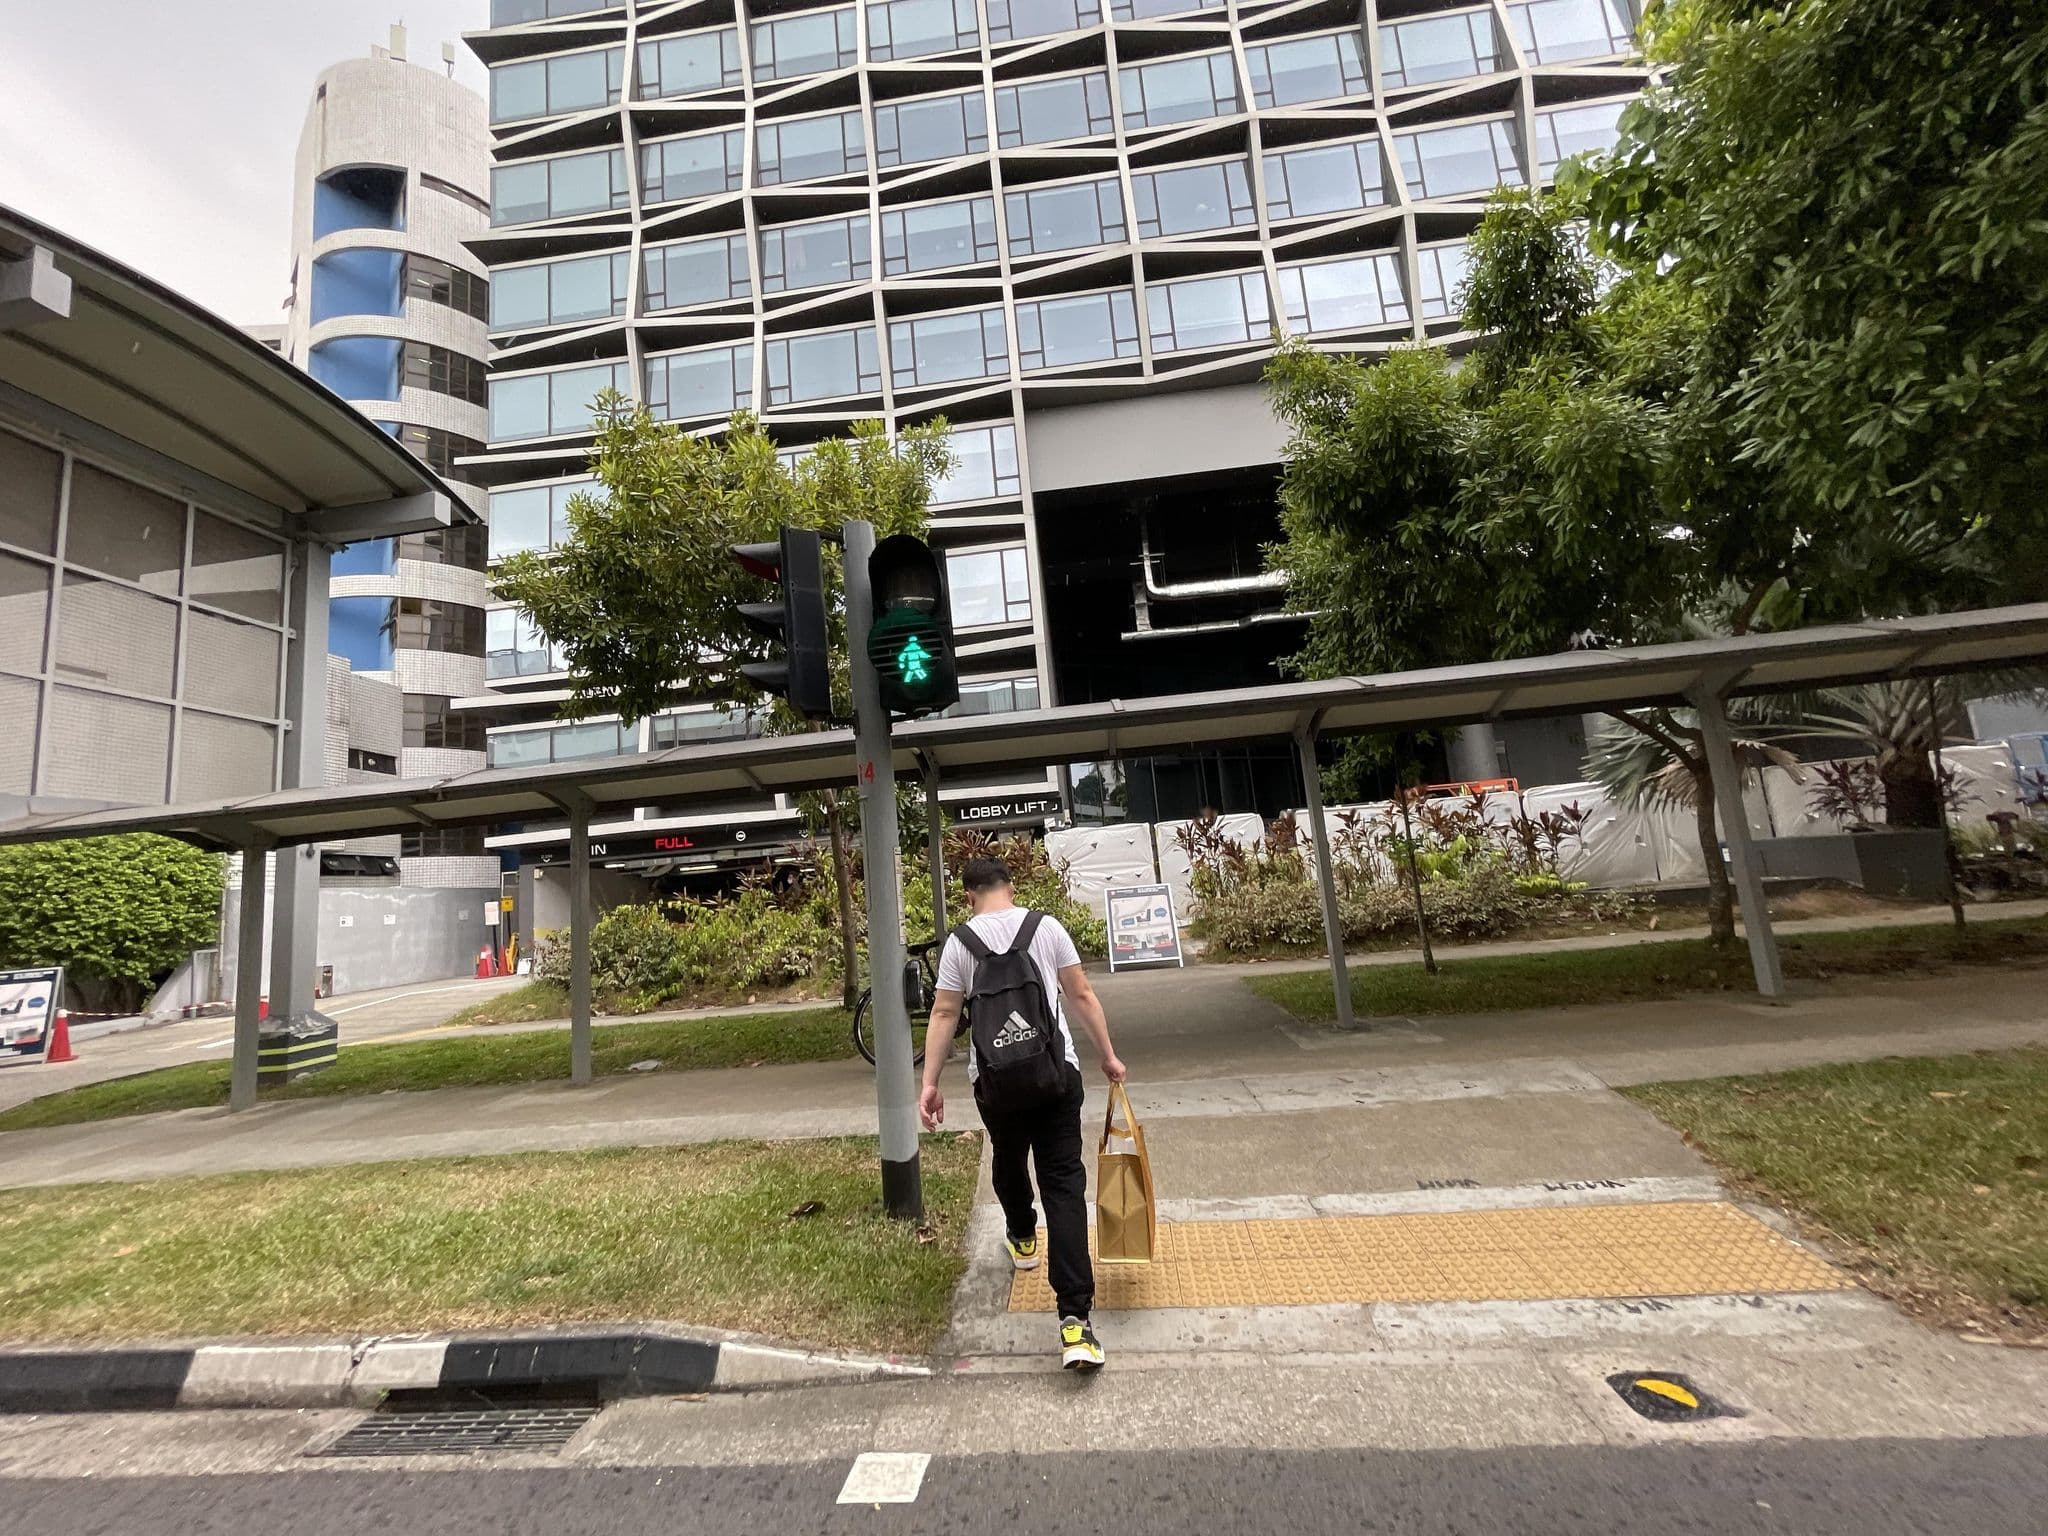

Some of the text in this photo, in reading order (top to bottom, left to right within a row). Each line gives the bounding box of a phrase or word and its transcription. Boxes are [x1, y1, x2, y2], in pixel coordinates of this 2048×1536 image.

[961, 801, 1047, 820] LOBBY LIFT
[591, 844, 606, 856] IN
[655, 836, 694, 849] FULL
[993, 1027, 1038, 1048] adidas
